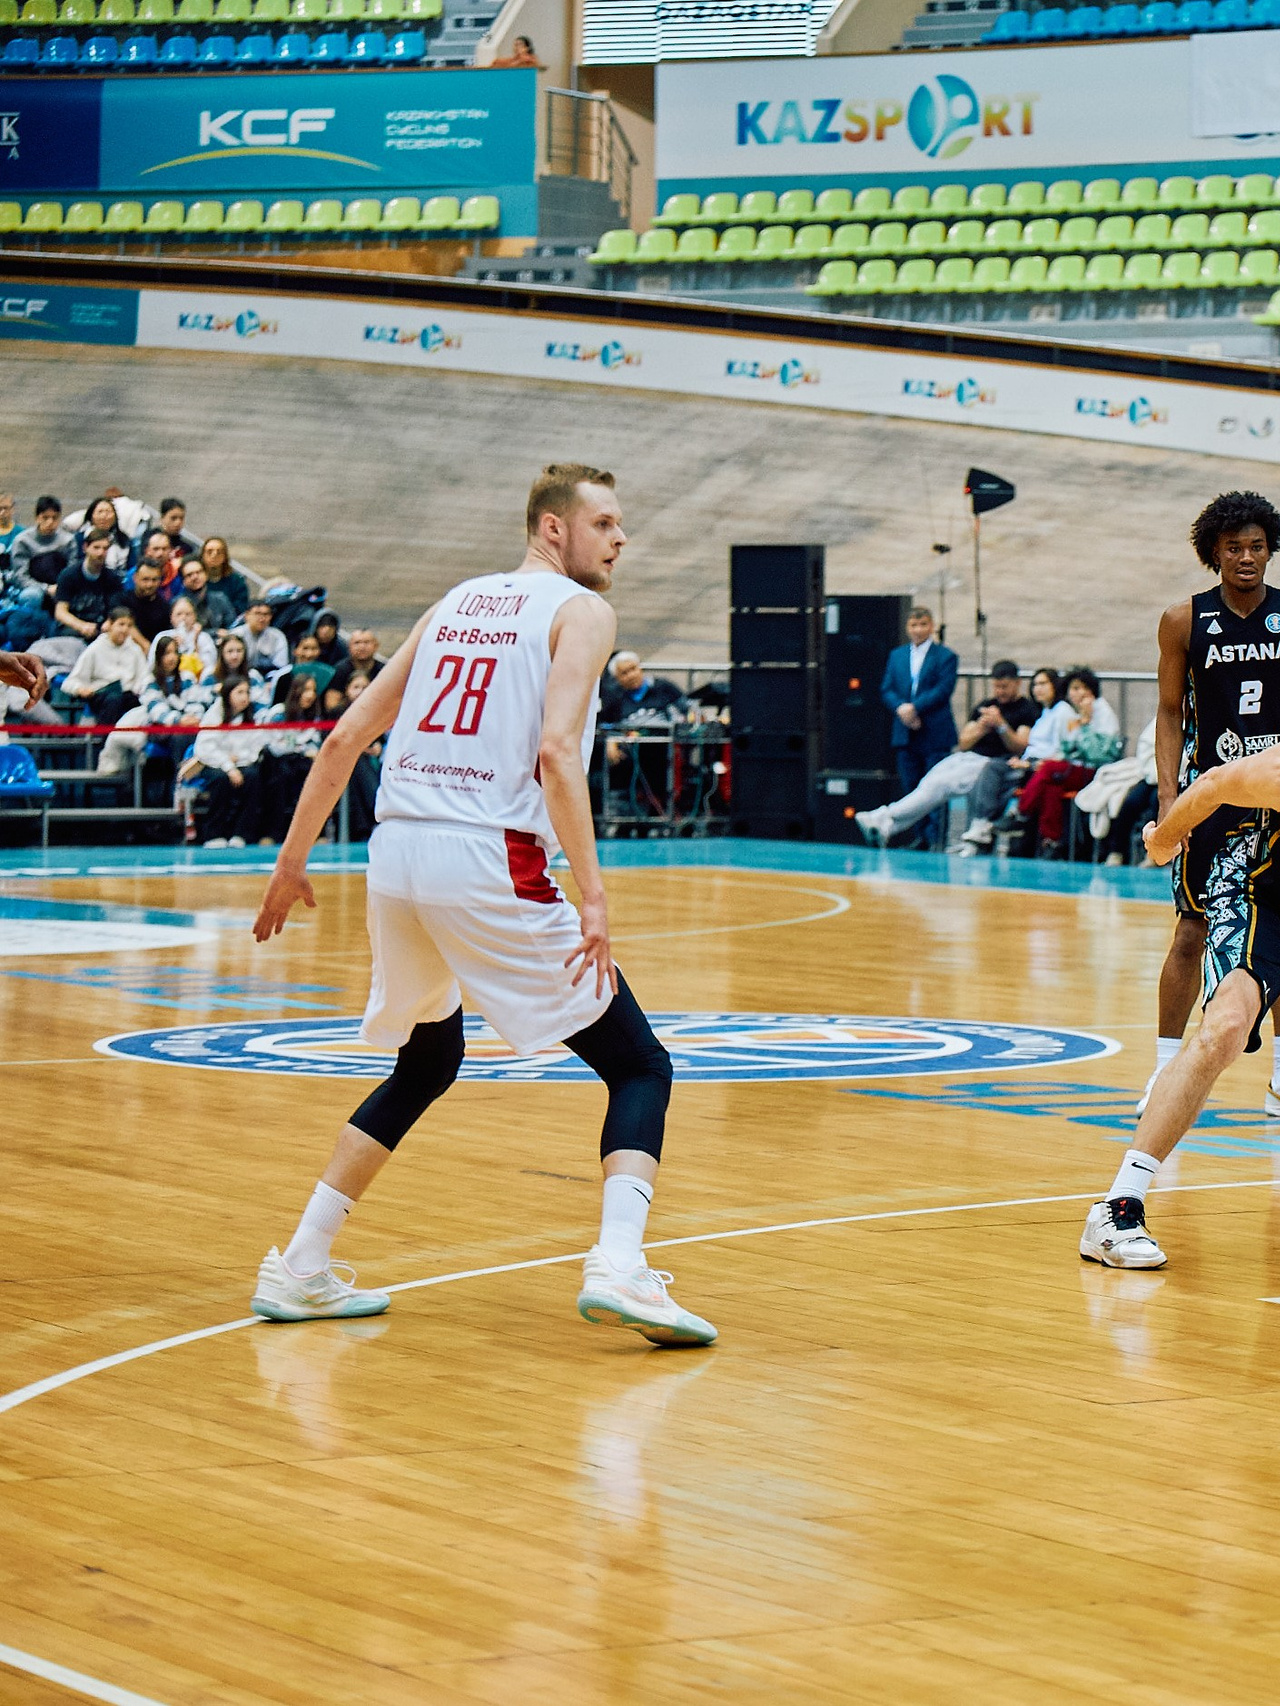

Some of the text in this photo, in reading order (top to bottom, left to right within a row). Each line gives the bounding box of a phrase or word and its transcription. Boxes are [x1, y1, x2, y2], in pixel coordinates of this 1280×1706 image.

[200, 108, 335, 146] KCF
[735, 74, 1041, 160] KAZSPORT
[0, 298, 48, 318] CF
[456, 592, 529, 618] LOPATIN
[435, 626, 518, 645] BetBoom
[417, 655, 498, 736] 28
[1238, 680, 1264, 715] 2
